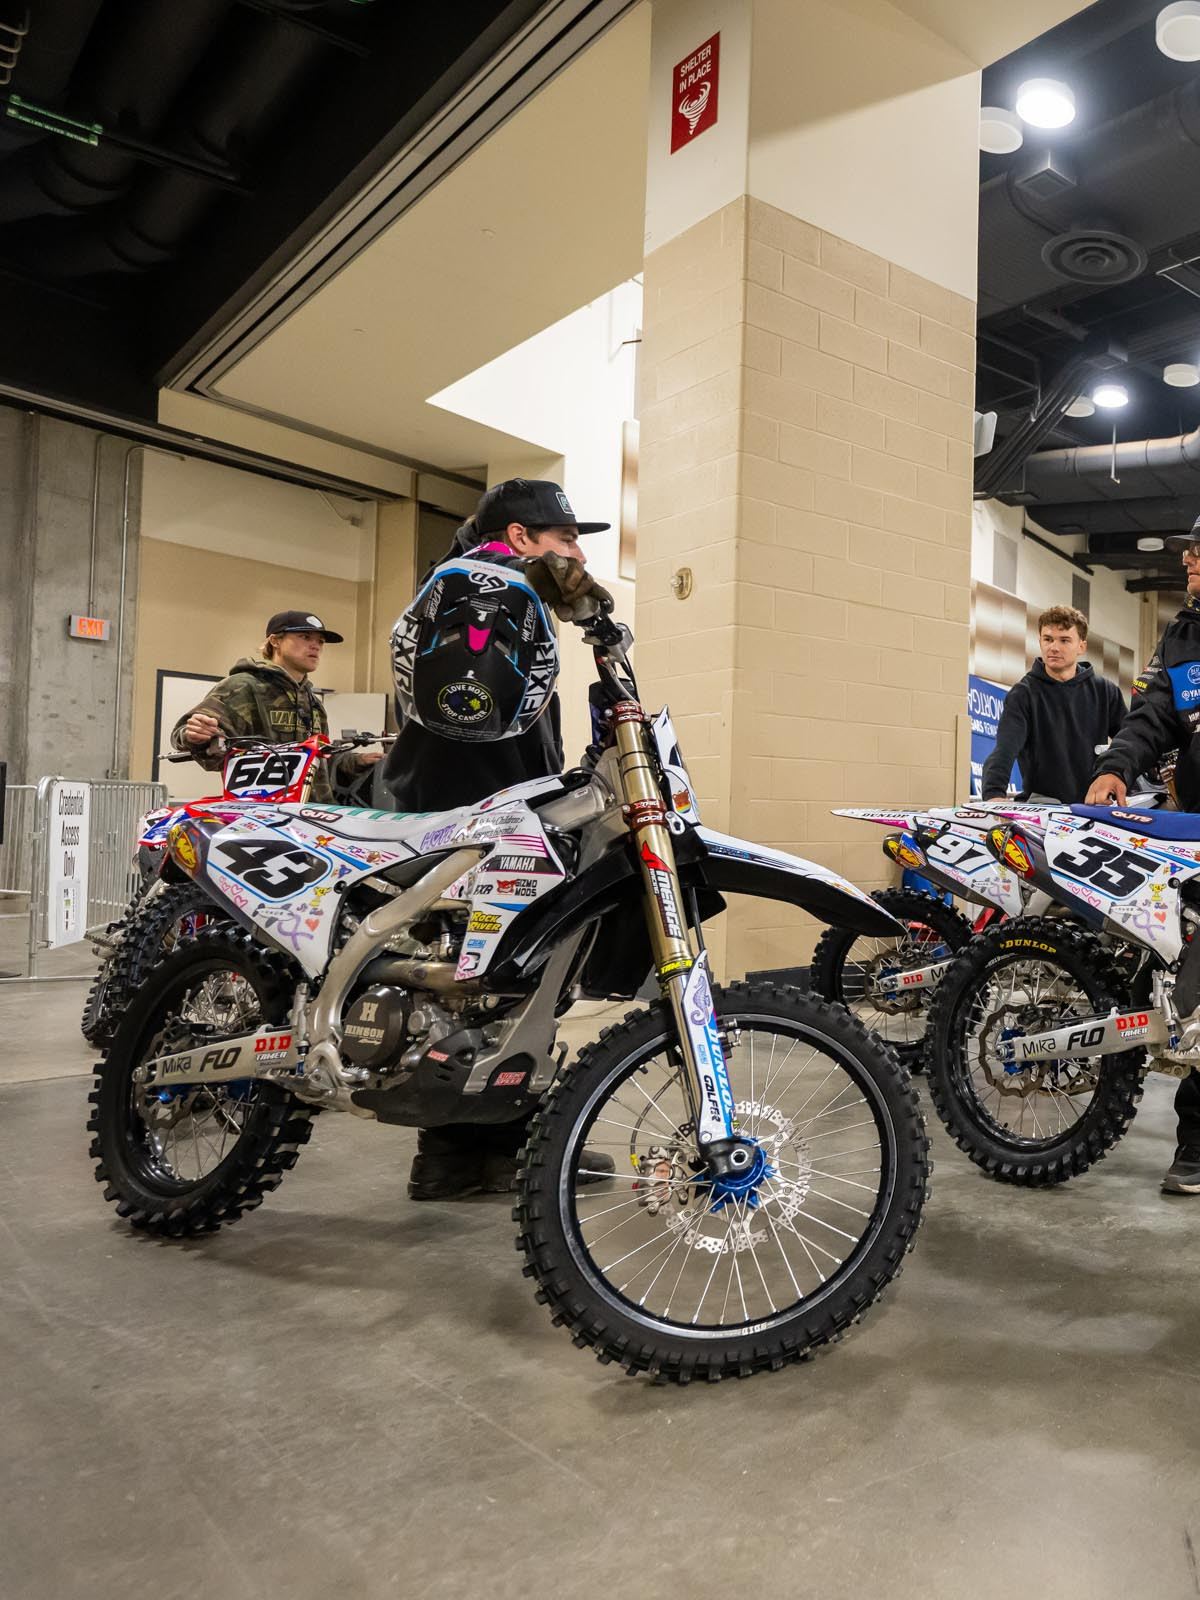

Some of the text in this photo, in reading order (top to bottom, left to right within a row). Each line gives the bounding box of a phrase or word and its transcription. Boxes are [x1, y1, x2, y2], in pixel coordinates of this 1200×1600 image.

[681, 45, 711, 77] SHELTER
[680, 60, 711, 93] IN PLACE
[77, 617, 104, 639] EXIT
[446, 685, 488, 701] LOVE MOTO
[441, 703, 488, 721] STOP CANCER
[227, 754, 302, 791] 68
[58, 789, 85, 816] Credential
[992, 805, 1047, 813] DUNLOP
[301, 811, 337, 821] GUTS
[1111, 810, 1153, 823] GUTS
[61, 820, 80, 846] Access
[499, 856, 537, 871] YAMAHA
[926, 833, 997, 874] 97
[63, 850, 76, 880] Only
[215, 840, 330, 898] 43
[1052, 836, 1162, 897] 35
[473, 884, 494, 896] FXR
[514, 888, 538, 897] MODS
[515, 879, 538, 888] GIZMO
[655, 869, 683, 940] MERGE
[469, 921, 503, 933] RIVER
[471, 911, 502, 922] ROCK
[1005, 939, 1057, 953] DUNLOP
[660, 959, 693, 975] TAMER
[360, 1002, 379, 1023] H
[344, 1024, 386, 1040] HINSON
[1067, 1026, 1105, 1051] FLO
[1119, 1027, 1149, 1038] TAMER
[255, 1051, 288, 1061] TAMER
[1022, 1038, 1057, 1059] Mika
[161, 1055, 192, 1079] Mika
[199, 1046, 242, 1073] FLO
[703, 1074, 721, 1123] GALFER
